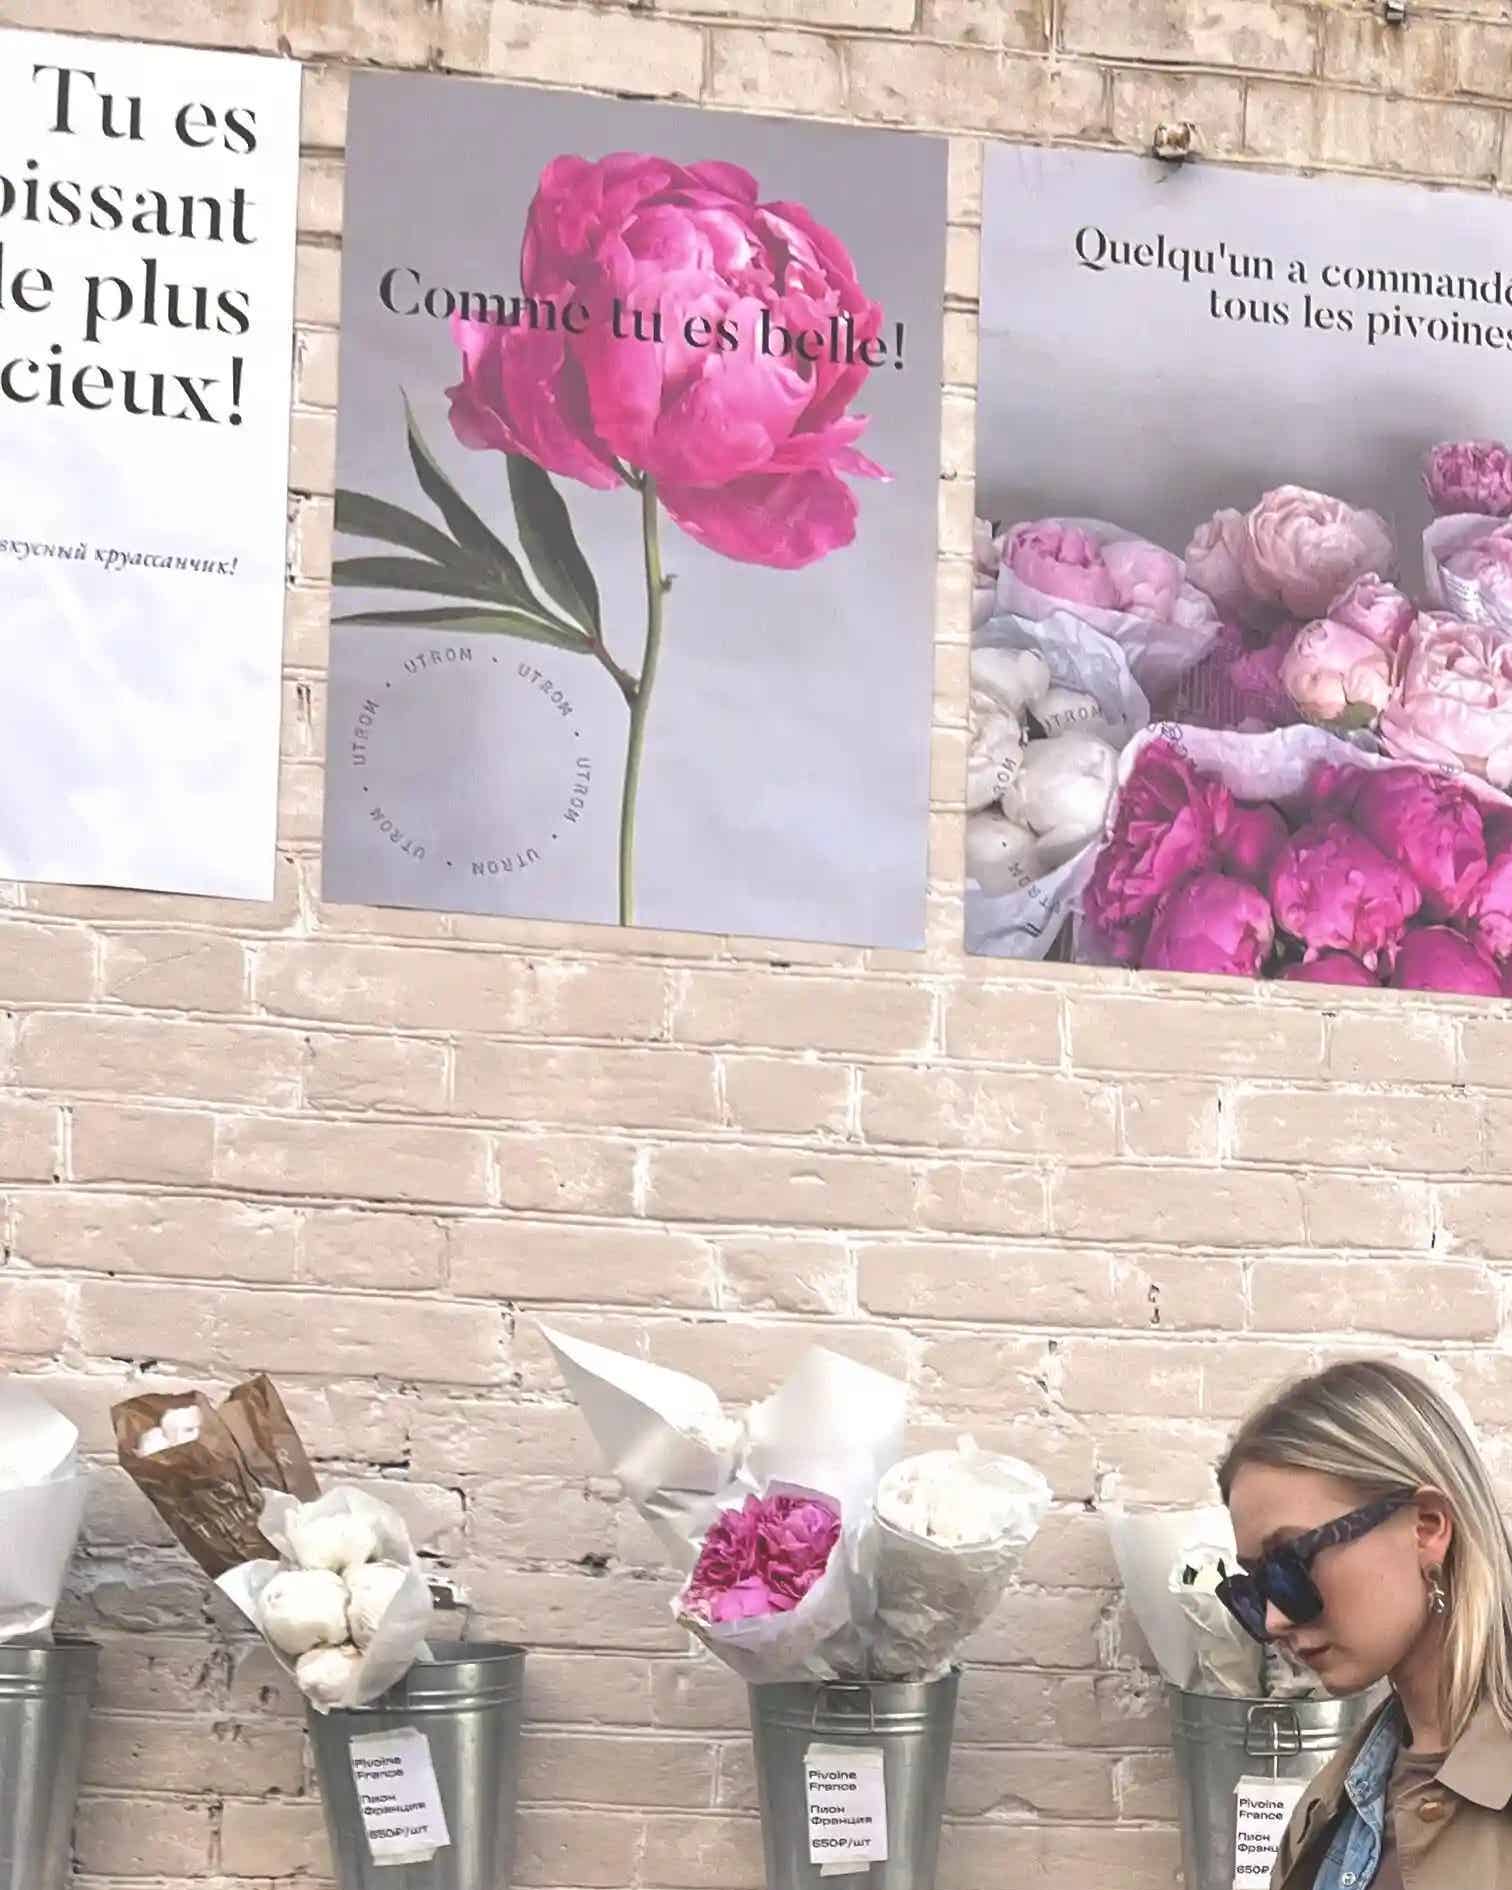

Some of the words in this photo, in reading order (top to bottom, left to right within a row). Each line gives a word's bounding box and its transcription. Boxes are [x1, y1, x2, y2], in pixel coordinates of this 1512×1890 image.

[32, 64, 146, 141] Tu
[175, 102, 258, 154] es
[1075, 224, 1275, 283] Quelqu'un
[1287, 258, 1308, 285] a
[0, 241, 54, 313] e
[83, 257, 250, 344] plus
[379, 266, 591, 335] Comme
[611, 297, 665, 345] tu
[683, 316, 740, 354] es
[759, 308, 905, 370] belle!
[1209, 289, 1290, 327] tous
[1303, 295, 1354, 333] les
[1, 343, 244, 426] cieux!
[94, 547, 239, 576] круассанчик!
[404, 647, 473, 675] UTROM
[517, 662, 574, 718] UTROM
[809, 1770, 857, 1780] Pivoine
[809, 1782, 857, 1792] France
[810, 1805, 845, 1814] Пион
[1239, 1798, 1284, 1809] Pivoine
[810, 1816, 873, 1826] Франция
[1239, 1810, 1283, 1820] France
[1238, 1832, 1270, 1841] Пион
[1237, 1843, 1280, 1854] Франц
